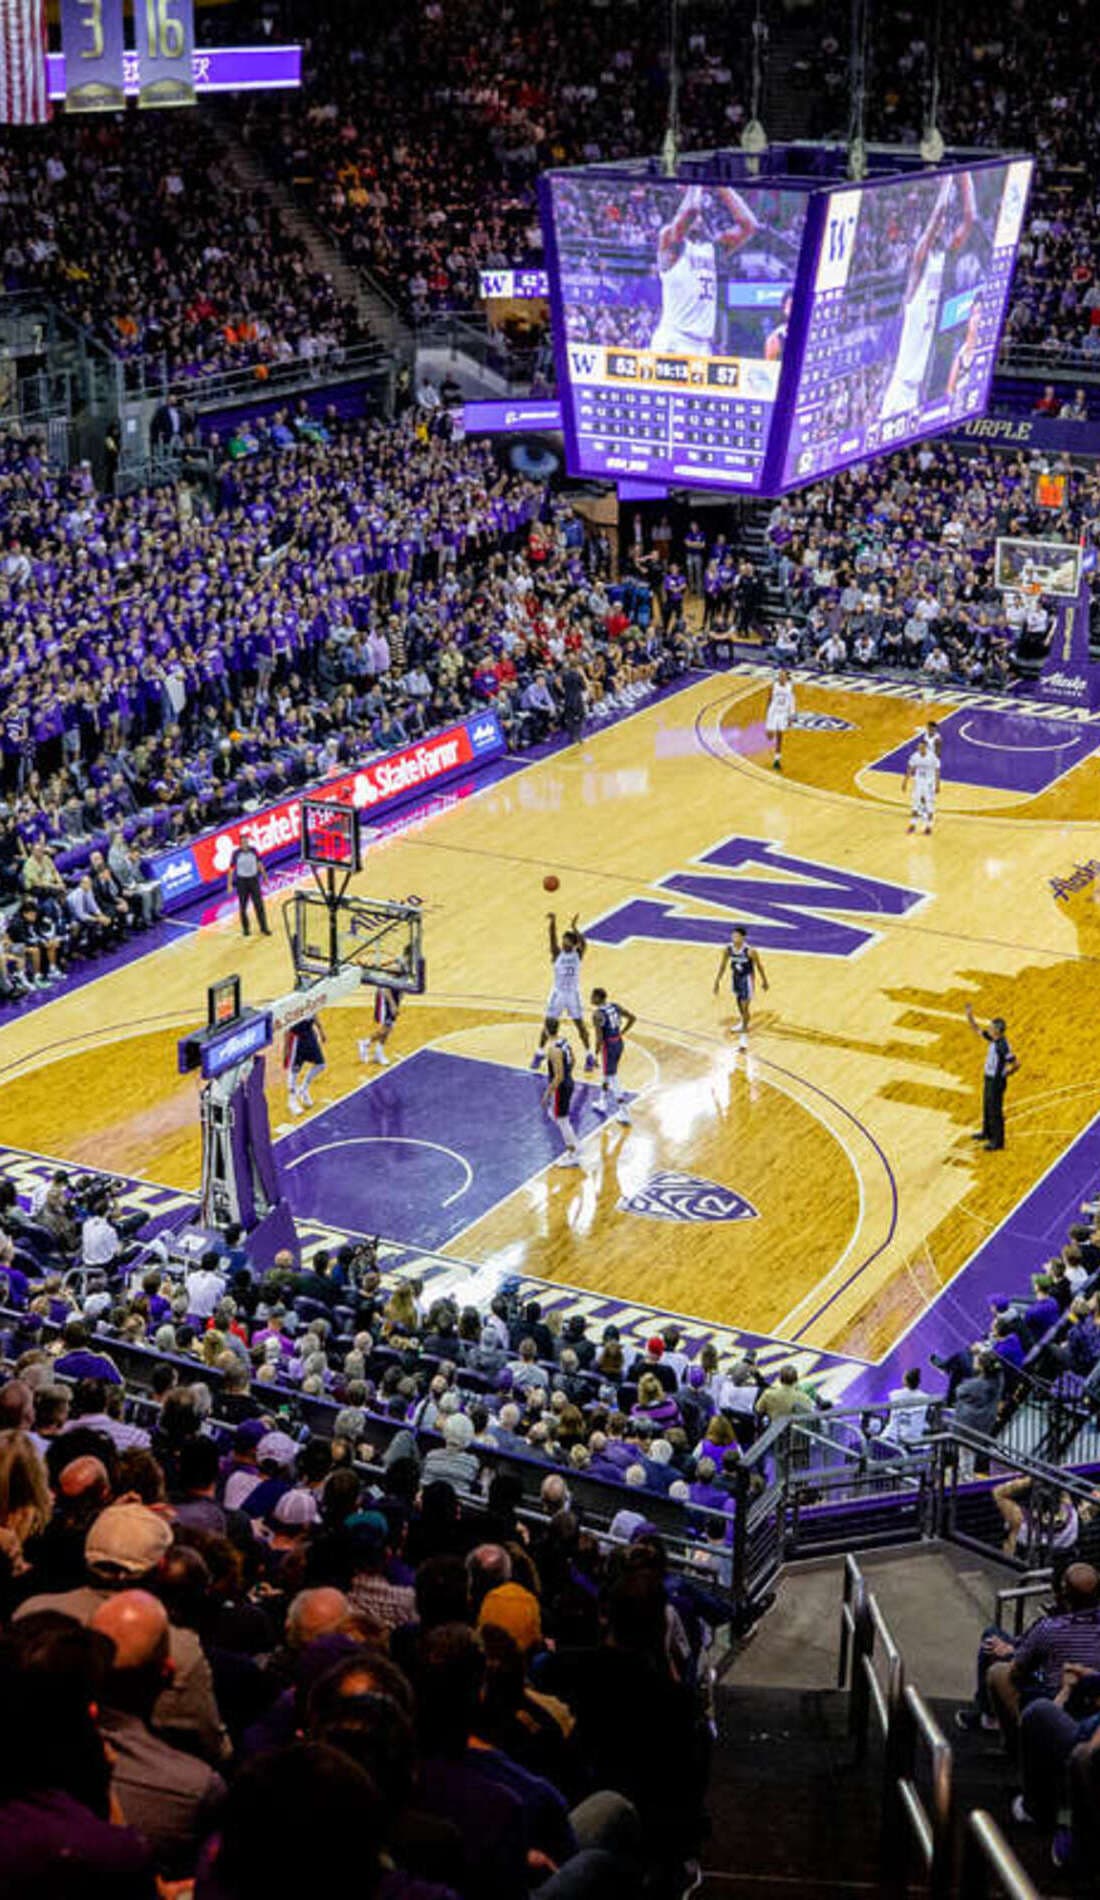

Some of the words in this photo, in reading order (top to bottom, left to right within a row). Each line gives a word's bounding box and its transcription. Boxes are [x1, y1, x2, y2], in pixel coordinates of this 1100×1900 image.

[146, 0, 184, 59] 16
[570, 352, 598, 375] W
[580, 833, 936, 959] W
